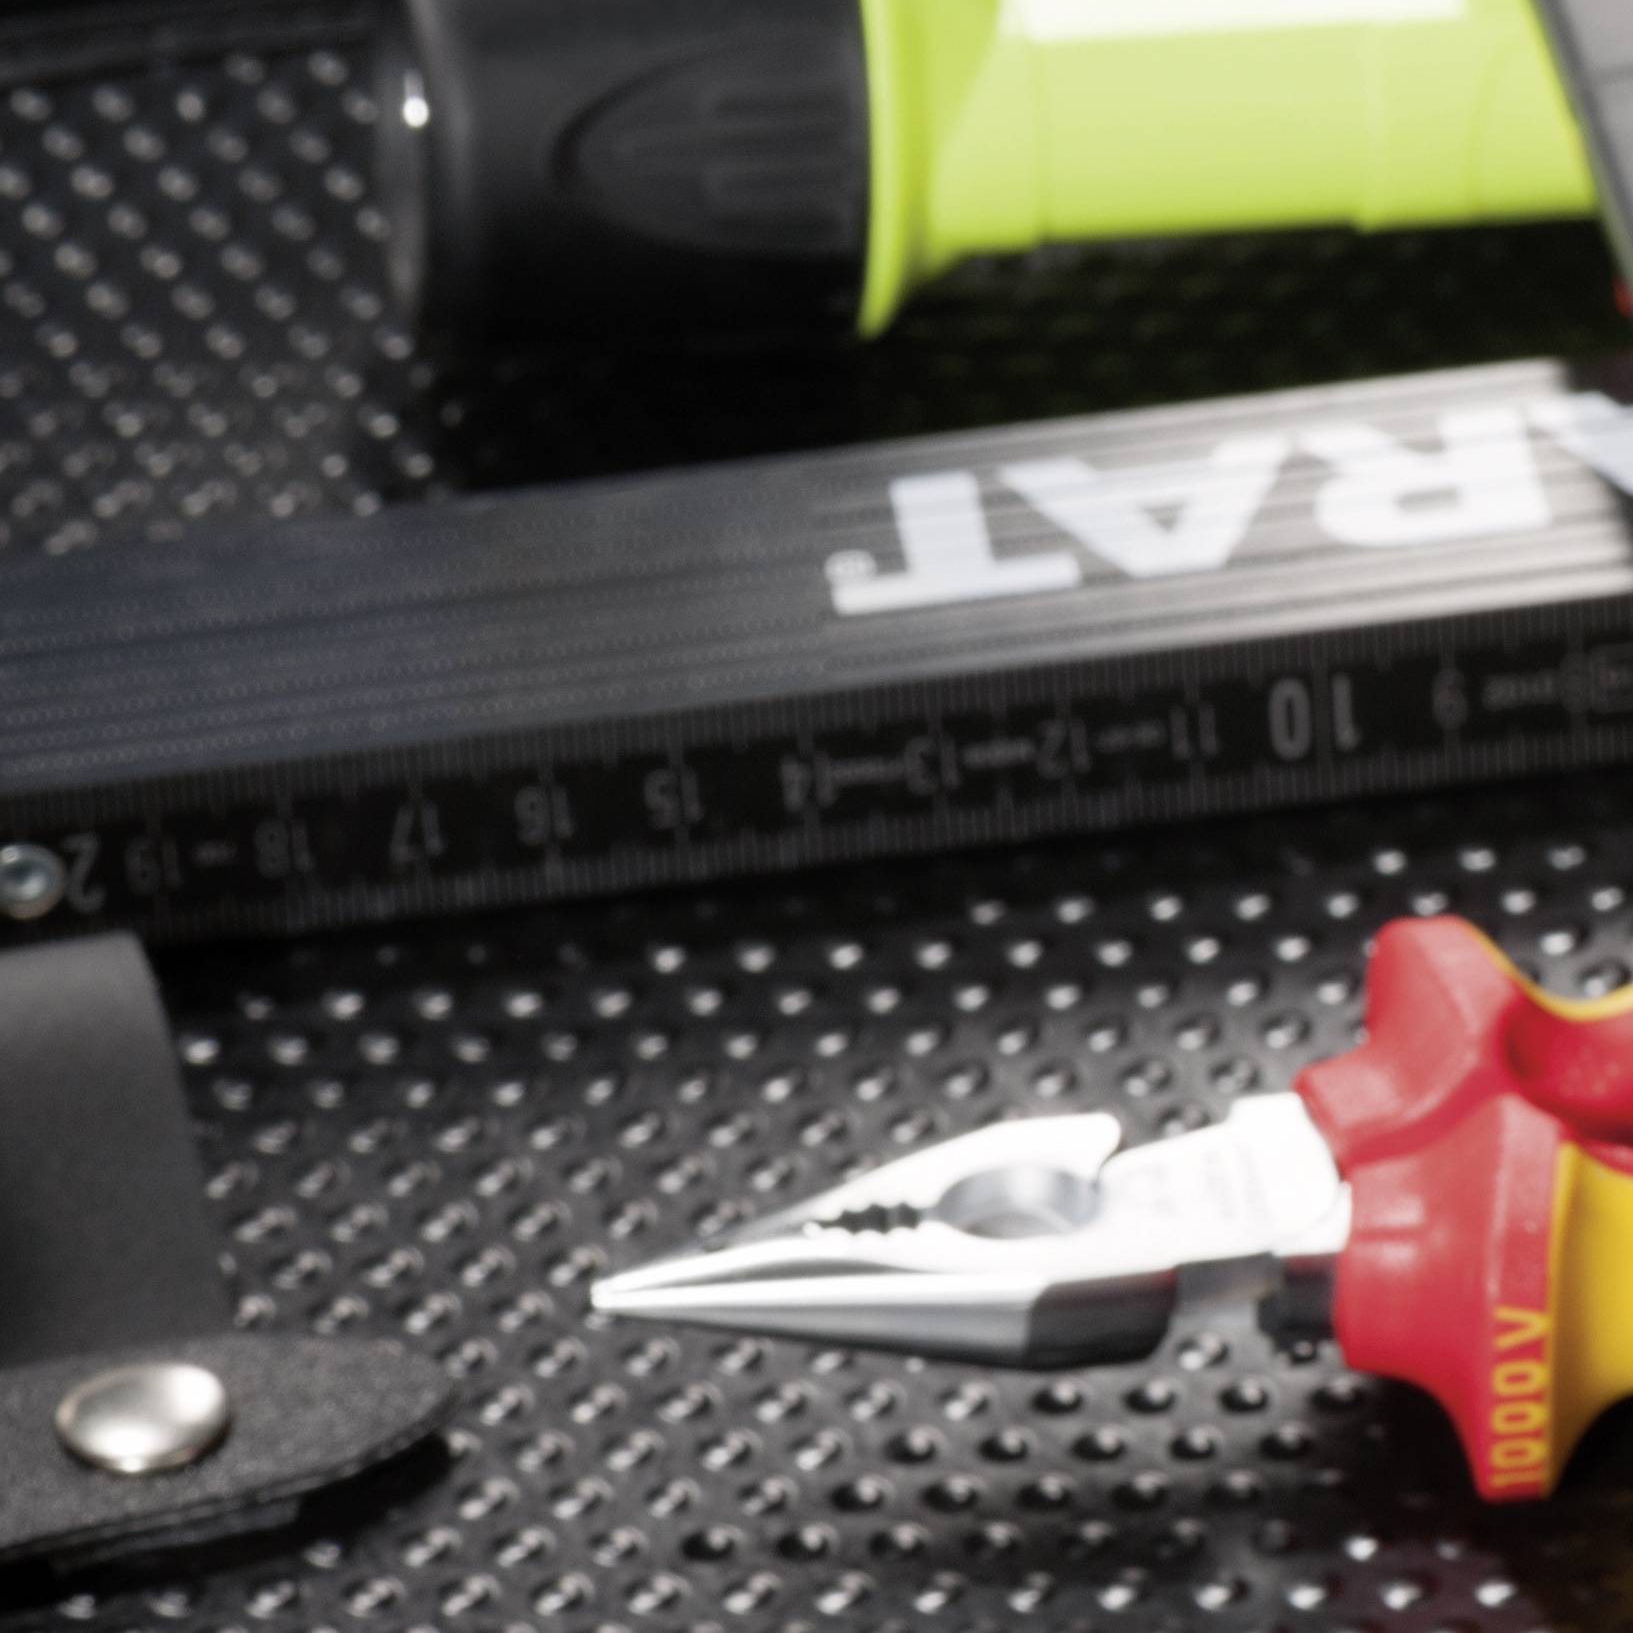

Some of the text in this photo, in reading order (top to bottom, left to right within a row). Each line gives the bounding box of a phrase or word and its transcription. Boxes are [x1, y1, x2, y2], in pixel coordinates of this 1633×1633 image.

[1164, 701, 1224, 763] 11
[1267, 673, 1362, 759] 10
[905, 733, 961, 796] 13
[1036, 717, 1093, 779] 12
[643, 770, 704, 830] 15
[782, 750, 838, 812] 14
[391, 803, 445, 864] 17
[514, 786, 576, 846] 16
[254, 819, 312, 877] 18
[1490, 1305, 1551, 1488] 1000V
